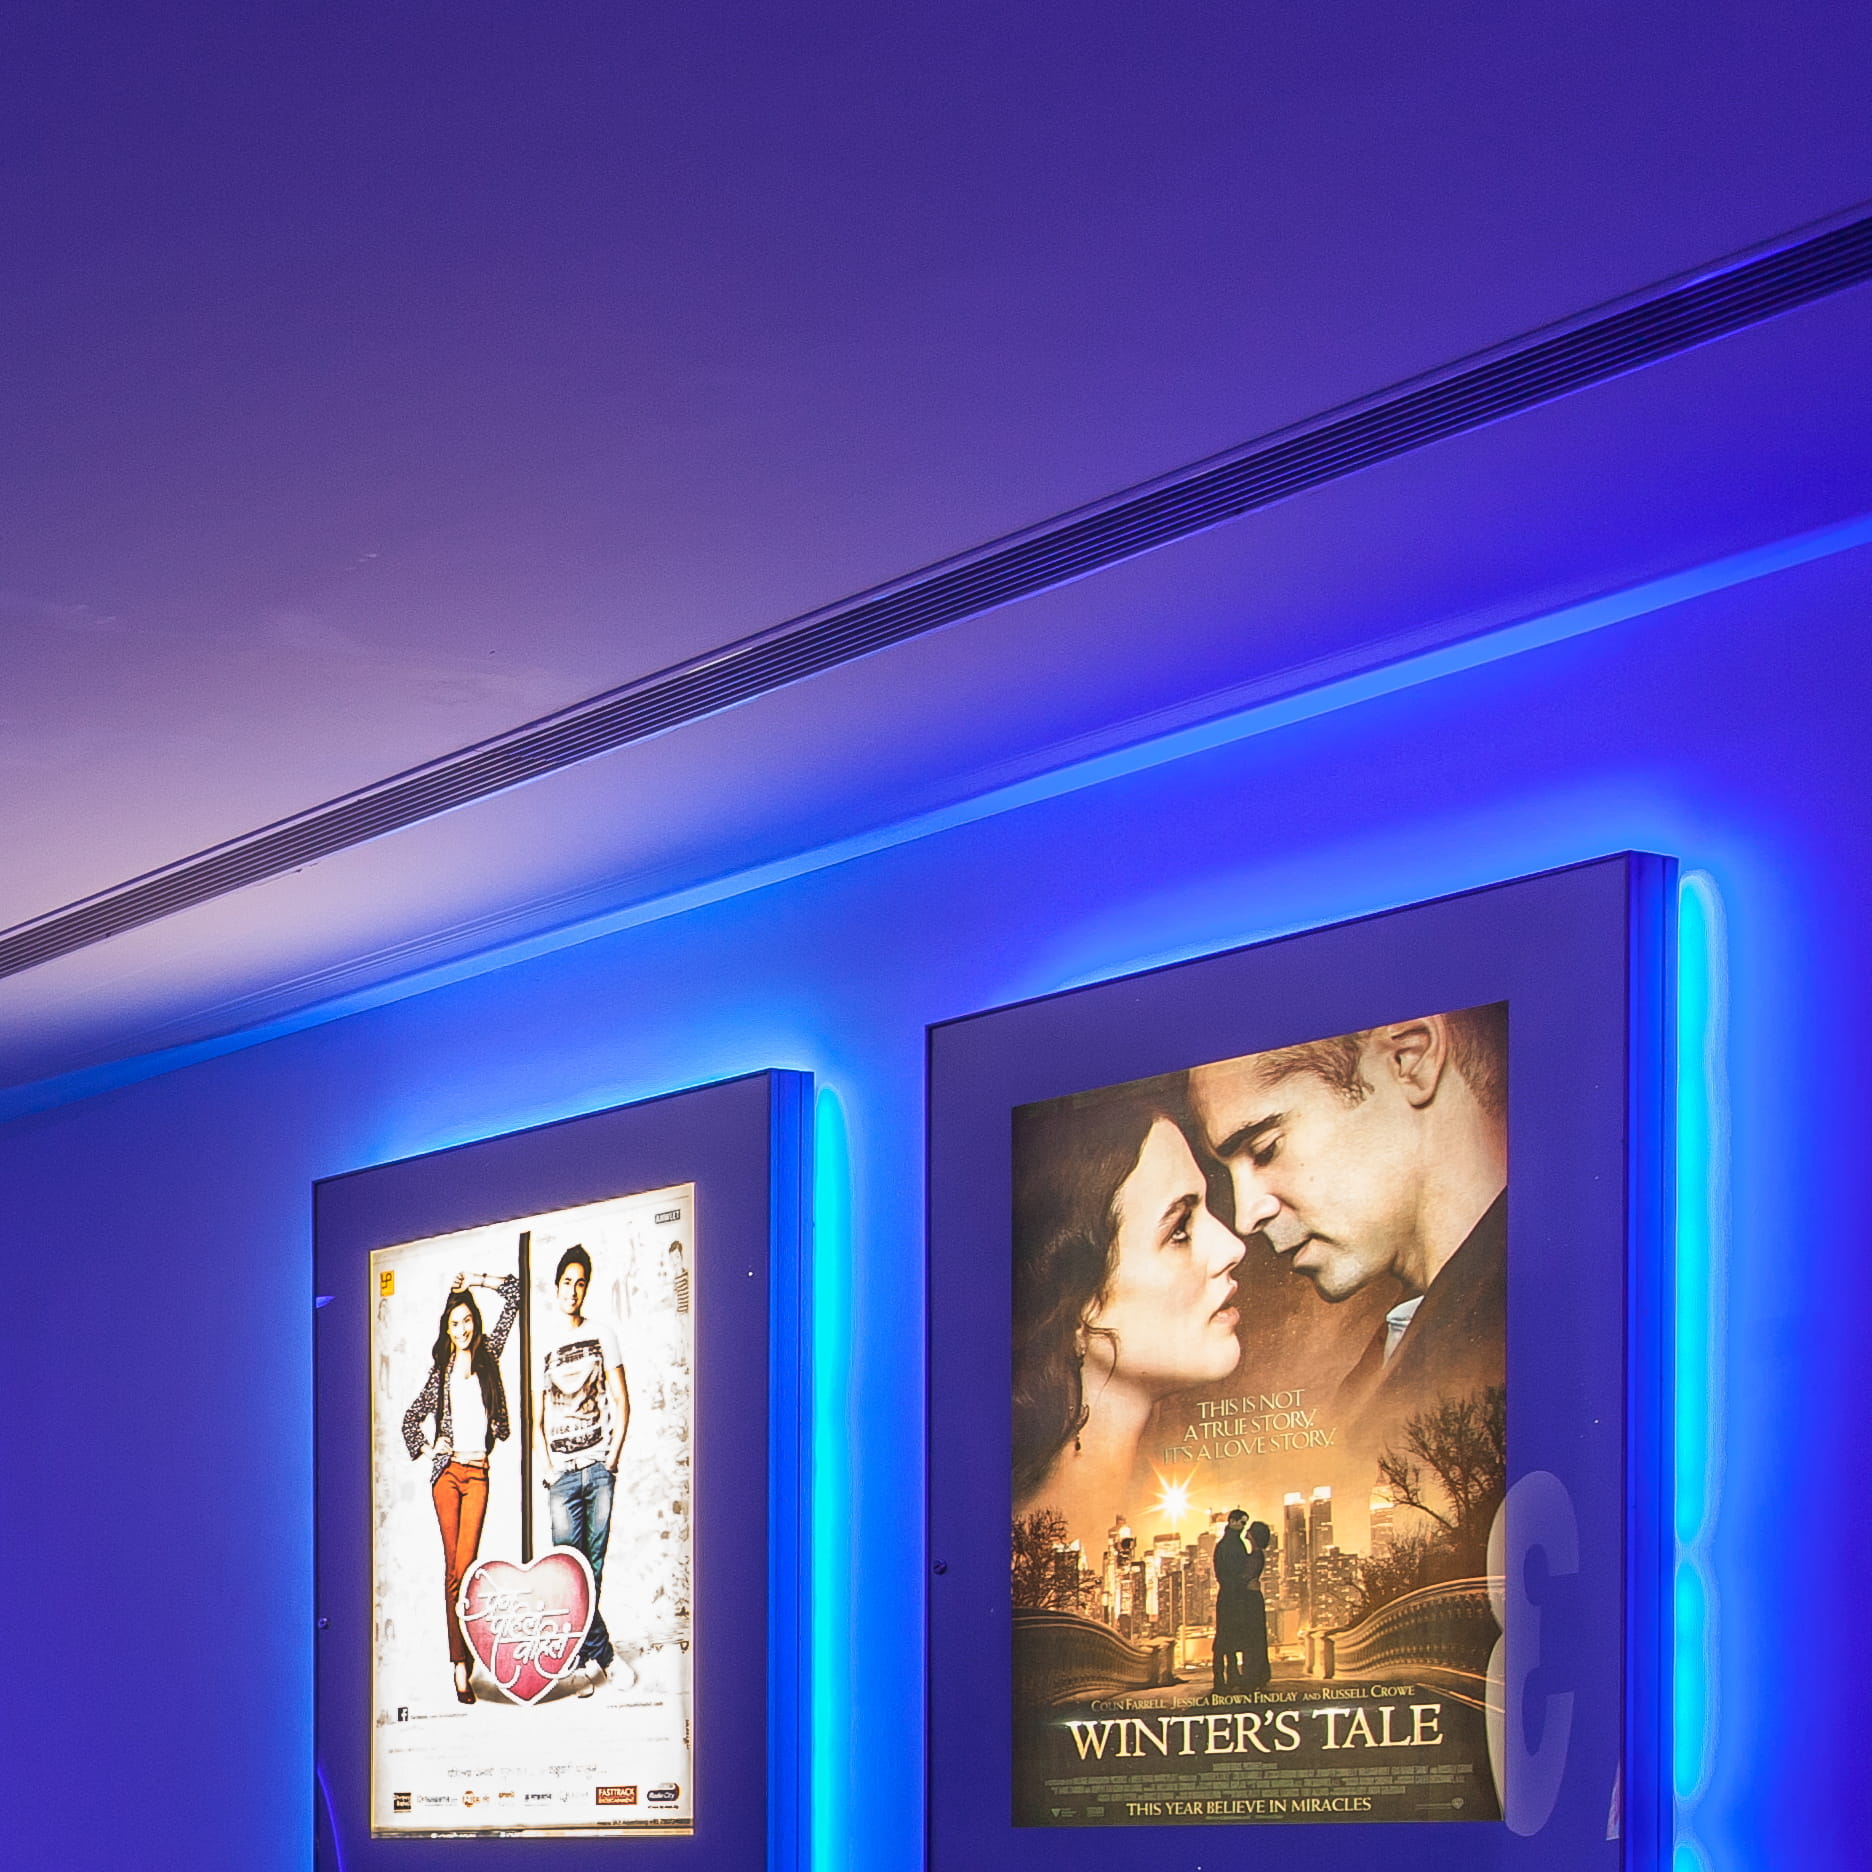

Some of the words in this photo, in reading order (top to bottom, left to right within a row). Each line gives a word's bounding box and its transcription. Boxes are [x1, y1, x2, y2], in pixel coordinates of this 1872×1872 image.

[1197, 1398, 1238, 1418] THIS
[1242, 1396, 1256, 1413] IS
[1260, 1389, 1305, 1411] NOT
[1184, 1425, 1198, 1441] A
[1199, 1418, 1248, 1439] TRUE
[1251, 1409, 1318, 1433] STORY.
[1163, 1445, 1193, 1464] IT'S
[1196, 1445, 1212, 1460] A
[1215, 1436, 1265, 1459] LOVE
[1270, 1428, 1337, 1451] STORY.
[1064, 1710, 1302, 1760] WINTER'S
[1312, 1704, 1444, 1750] TALE
[598, 1788, 636, 1797] FASTTRACK
[1126, 1802, 1162, 1816] THIS
[1165, 1802, 1203, 1815] YEAR
[1207, 1799, 1266, 1814] BELIEVE
[1269, 1800, 1286, 1812] IN
[1291, 1797, 1372, 1812] MIRACLES
